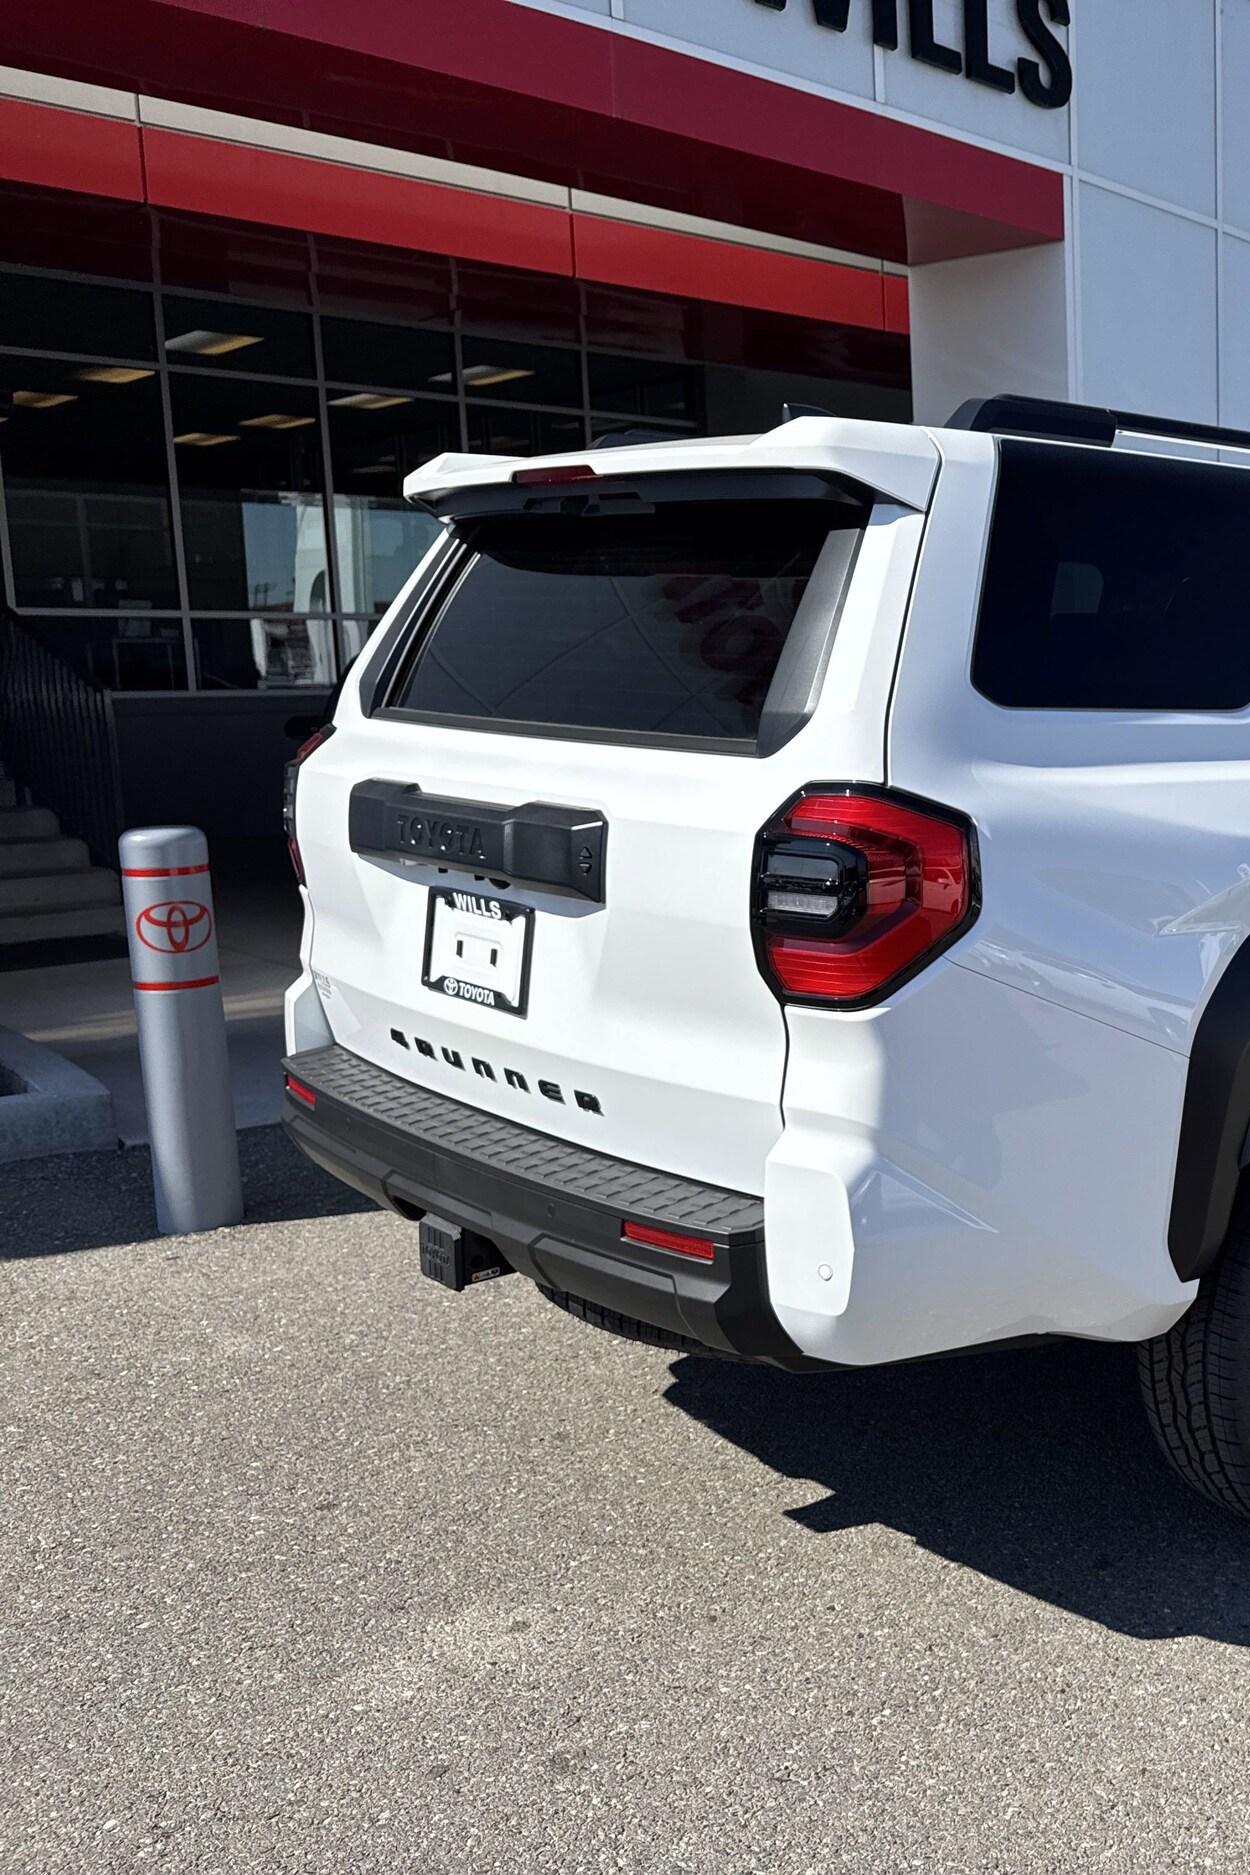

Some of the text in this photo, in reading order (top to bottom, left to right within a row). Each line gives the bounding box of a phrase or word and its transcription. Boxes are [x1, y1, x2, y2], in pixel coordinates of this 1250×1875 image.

[397, 813, 486, 857] TOYOTA
[453, 891, 502, 919] WILLS
[458, 983, 496, 1007] TOYOTA
[390, 1028, 605, 1117] 4RUNNER
